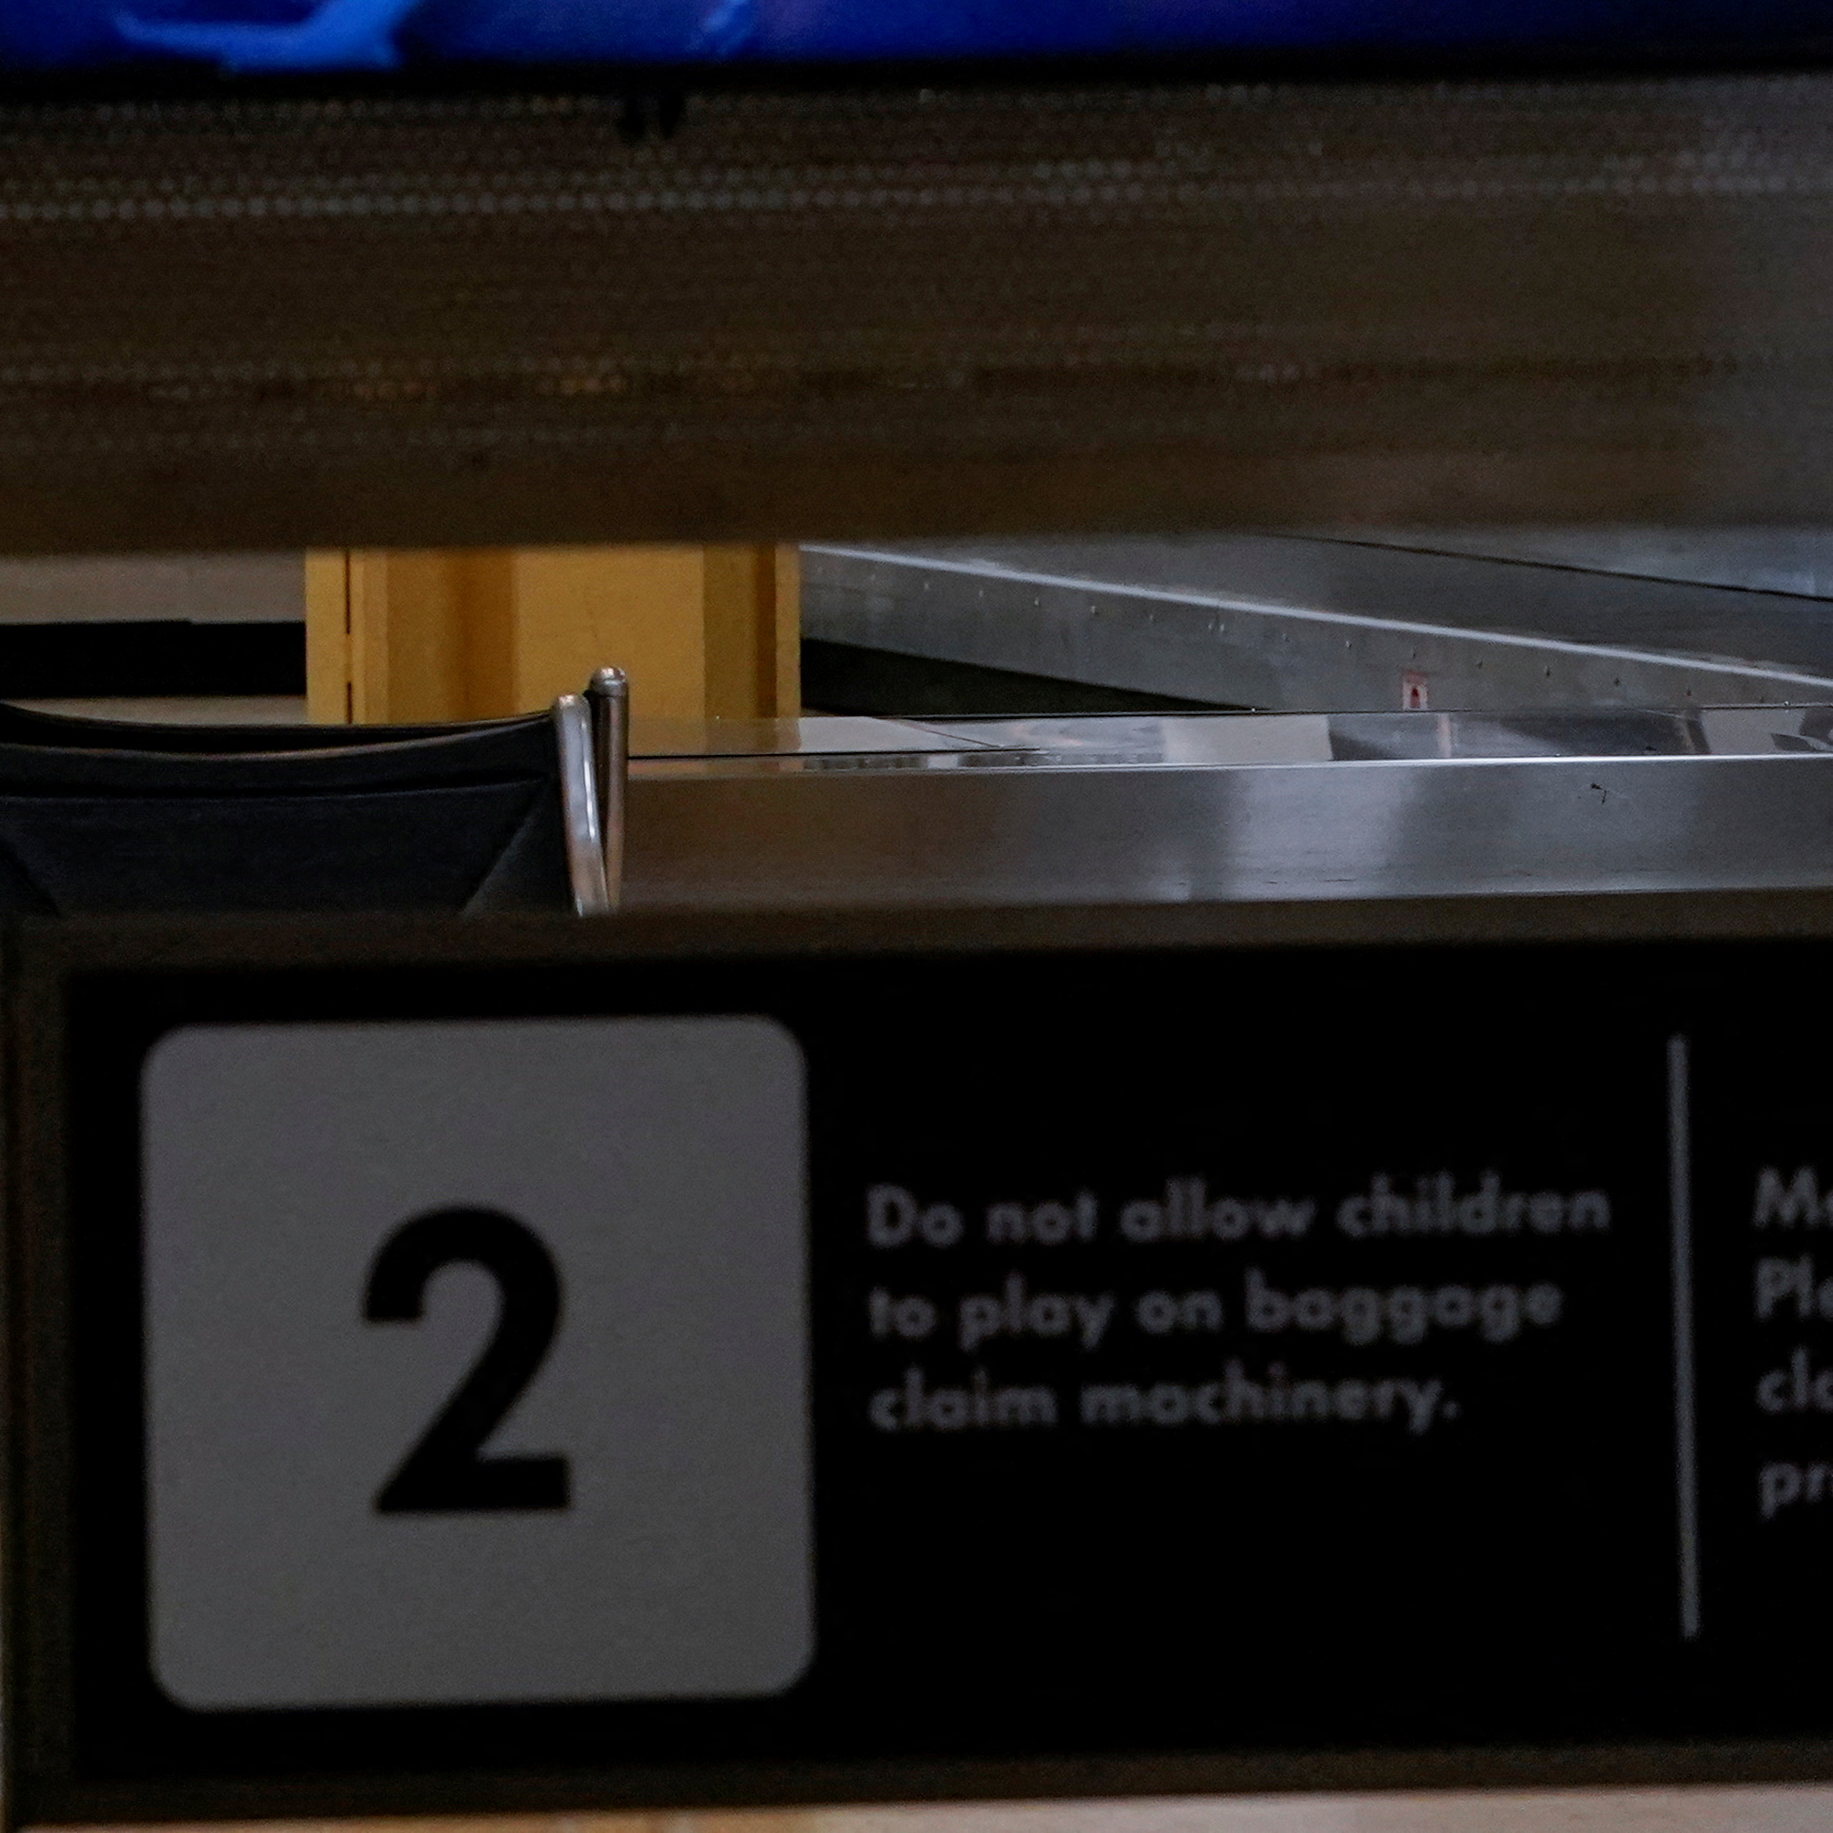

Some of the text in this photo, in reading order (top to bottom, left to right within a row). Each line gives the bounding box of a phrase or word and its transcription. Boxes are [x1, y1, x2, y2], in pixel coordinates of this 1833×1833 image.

[866, 1172, 1611, 1248] Do not allow children
[867, 1267, 1563, 1352] to play on baggage
[361, 1203, 573, 1518] 2
[868, 1362, 1458, 1435] claim machinery.
